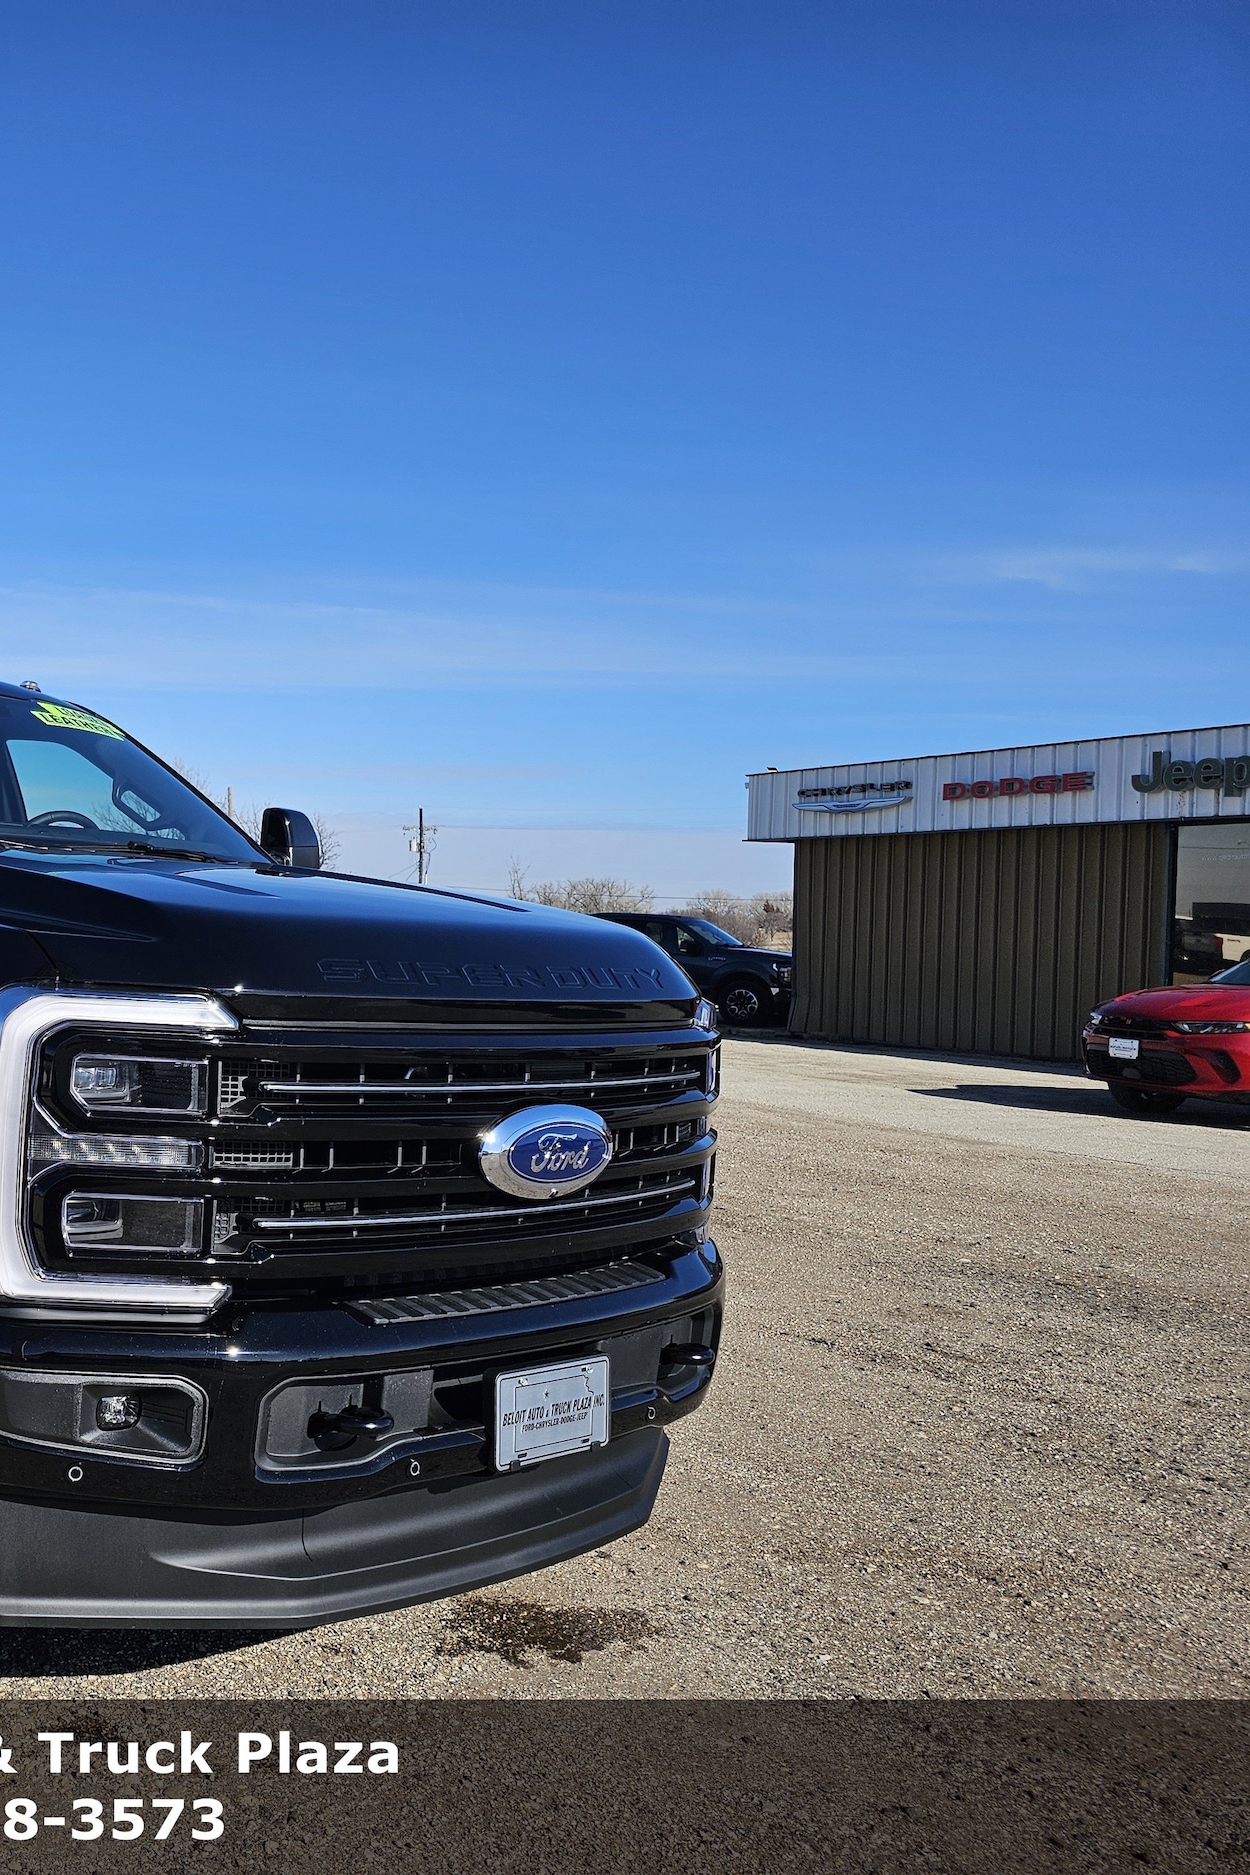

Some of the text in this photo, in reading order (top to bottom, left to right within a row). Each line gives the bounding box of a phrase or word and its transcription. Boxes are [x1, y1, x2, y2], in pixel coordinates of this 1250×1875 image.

[797, 780, 912, 798] CHRYSLER
[943, 771, 1094, 800] DODGE
[1131, 751, 1250, 797] Jeep
[316, 958, 664, 989] SUPER DUTY
[530, 1132, 592, 1174] Ford
[502, 1409, 527, 1427] BELOIT
[527, 1405, 545, 1422] AUTO
[551, 1401, 571, 1418] TRUCK
[572, 1395, 592, 1413] PLAZA
